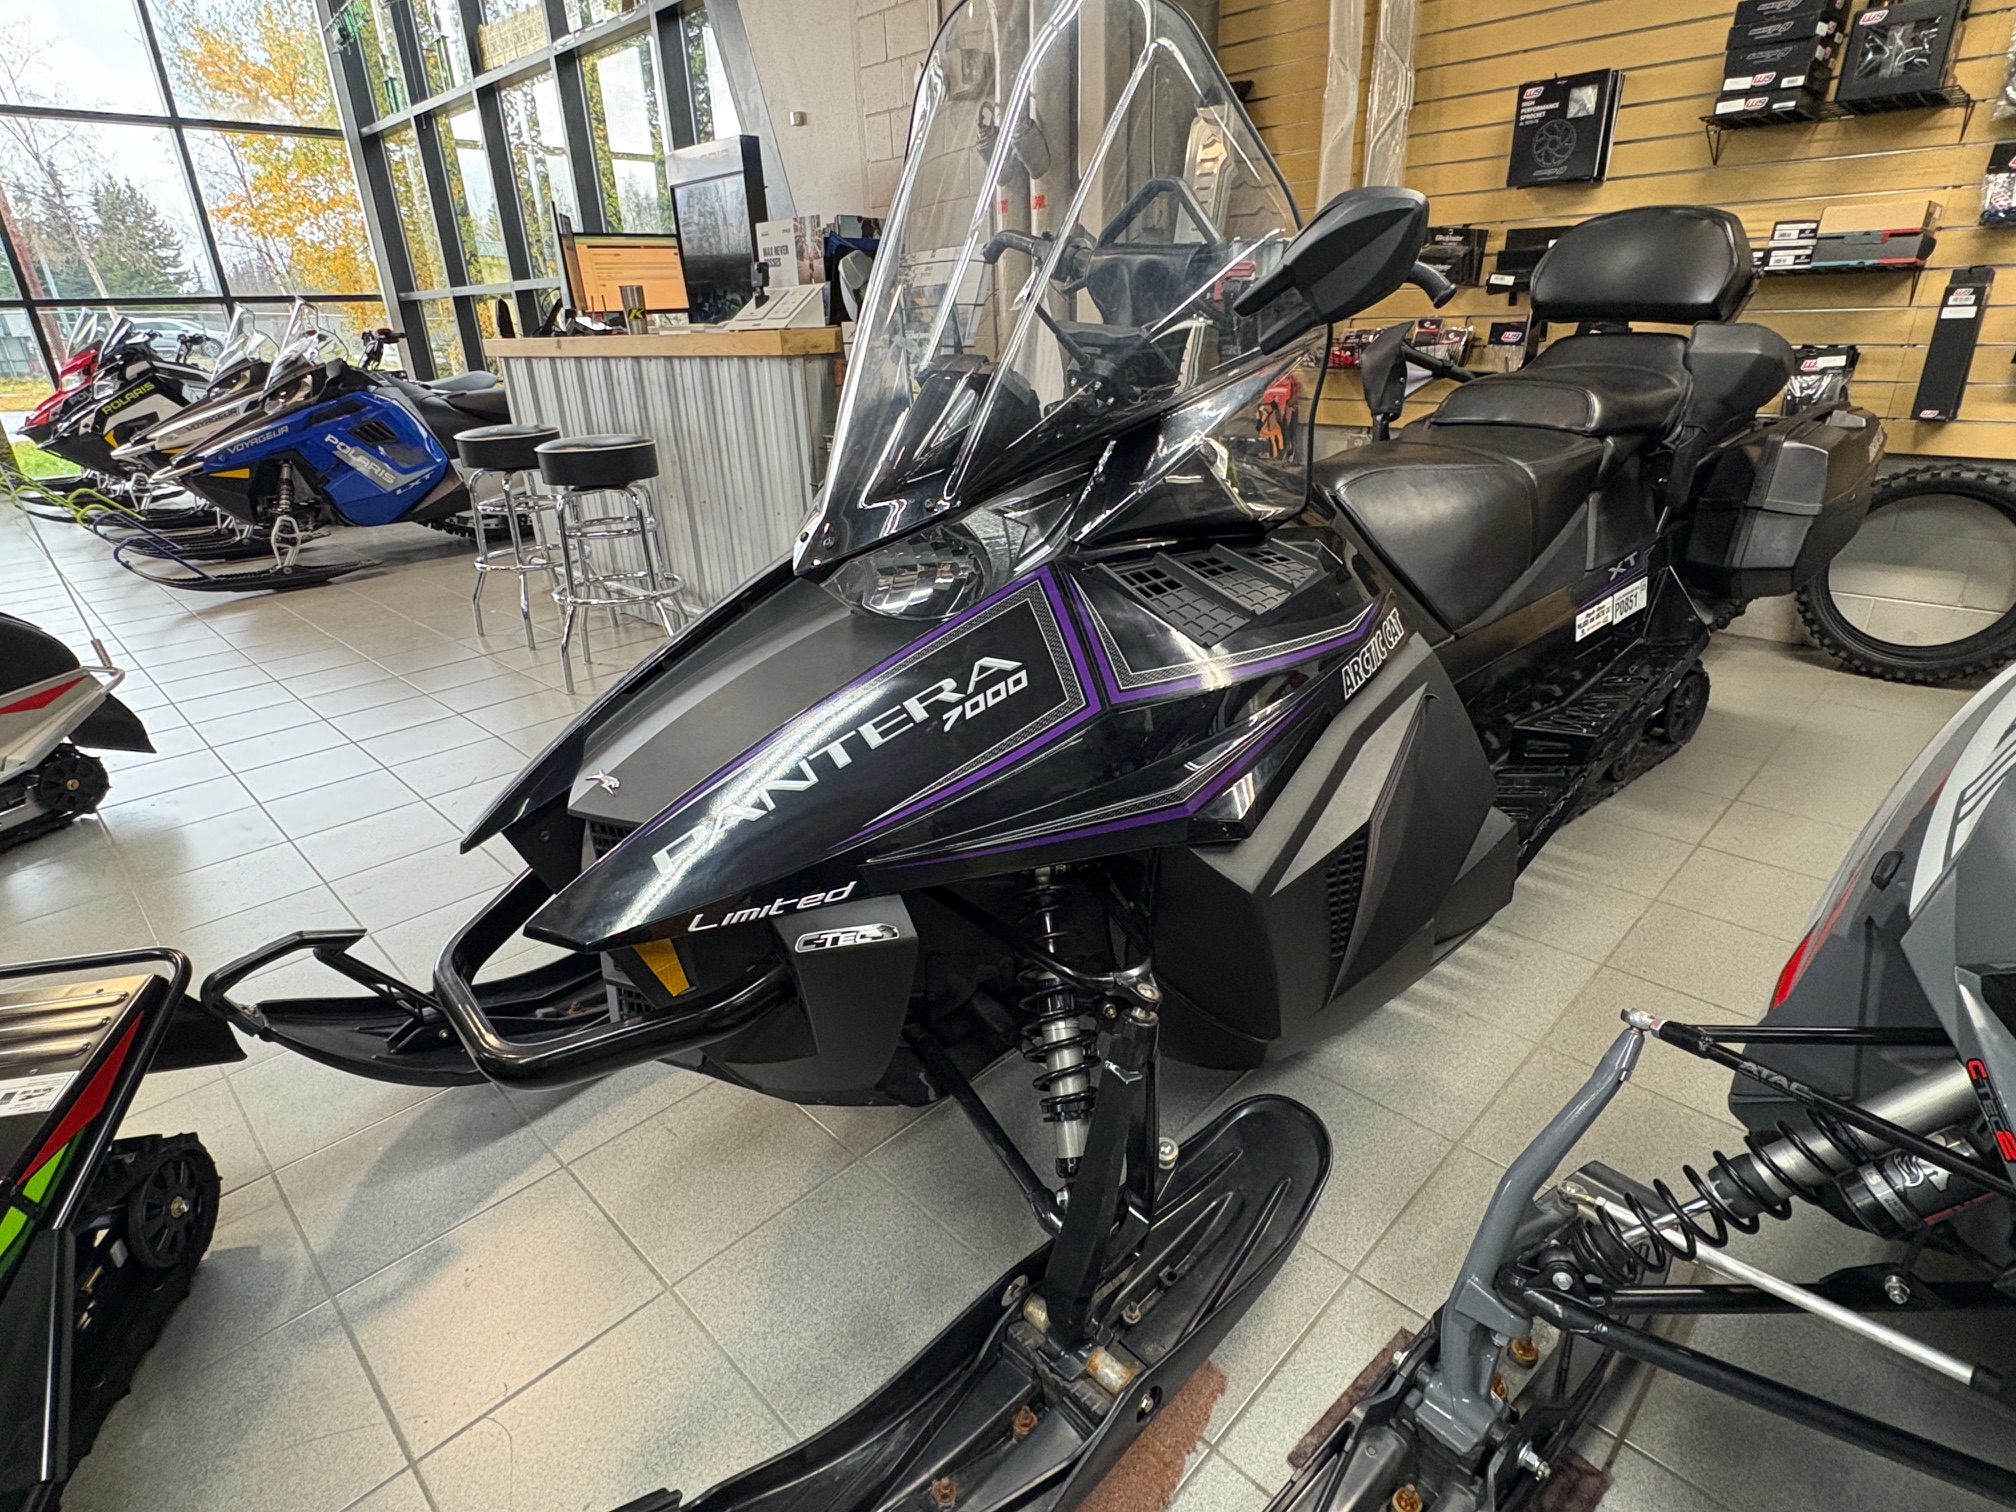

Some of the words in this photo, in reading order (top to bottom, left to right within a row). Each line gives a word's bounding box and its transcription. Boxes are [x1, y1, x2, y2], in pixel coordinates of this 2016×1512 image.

[101, 381, 156, 415] POLARIS
[185, 407, 238, 432] VOYAGEUR
[227, 425, 290, 454] VOYAGEUR
[324, 433, 396, 484] POLARIS
[396, 470, 435, 495] LXT
[1607, 550, 1638, 581] XT
[1615, 592, 1639, 619] P0851
[1341, 629, 1388, 700] ARCTIC
[1381, 606, 1405, 650] CAT
[942, 669, 1029, 732] 7000
[651, 655, 1023, 878] PANTERA
[687, 880, 858, 933] Limited
